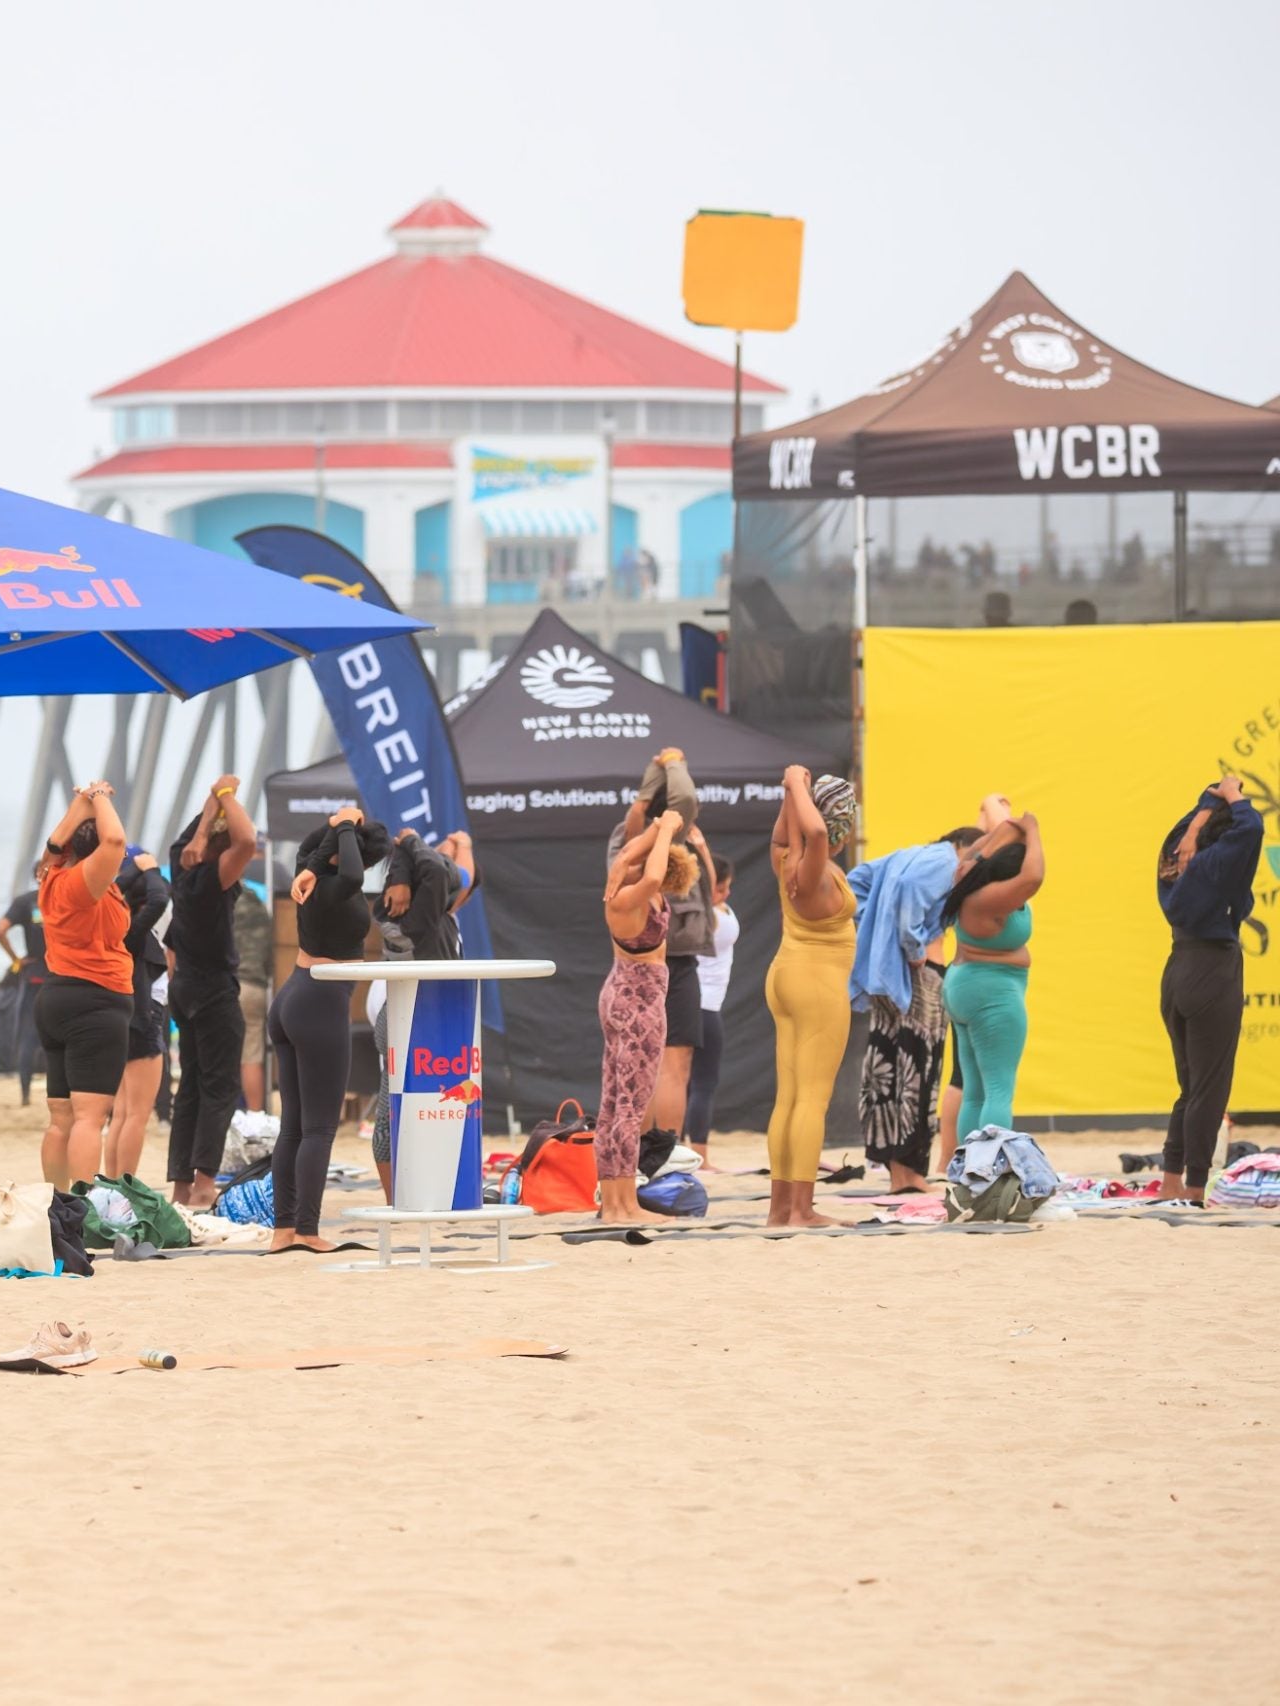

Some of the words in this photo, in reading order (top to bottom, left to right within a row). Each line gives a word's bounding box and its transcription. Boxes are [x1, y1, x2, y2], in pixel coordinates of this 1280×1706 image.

[1013, 424, 1162, 480] WCBR
[522, 714, 571, 730] NEW
[580, 713, 651, 727] EARTH
[533, 726, 651, 742] APPROVED
[529, 786, 618, 808] Solutions
[621, 786, 639, 804] fo
[697, 784, 740, 805] althy
[744, 783, 785, 801] Plan
[413, 1045, 468, 1077] Red
